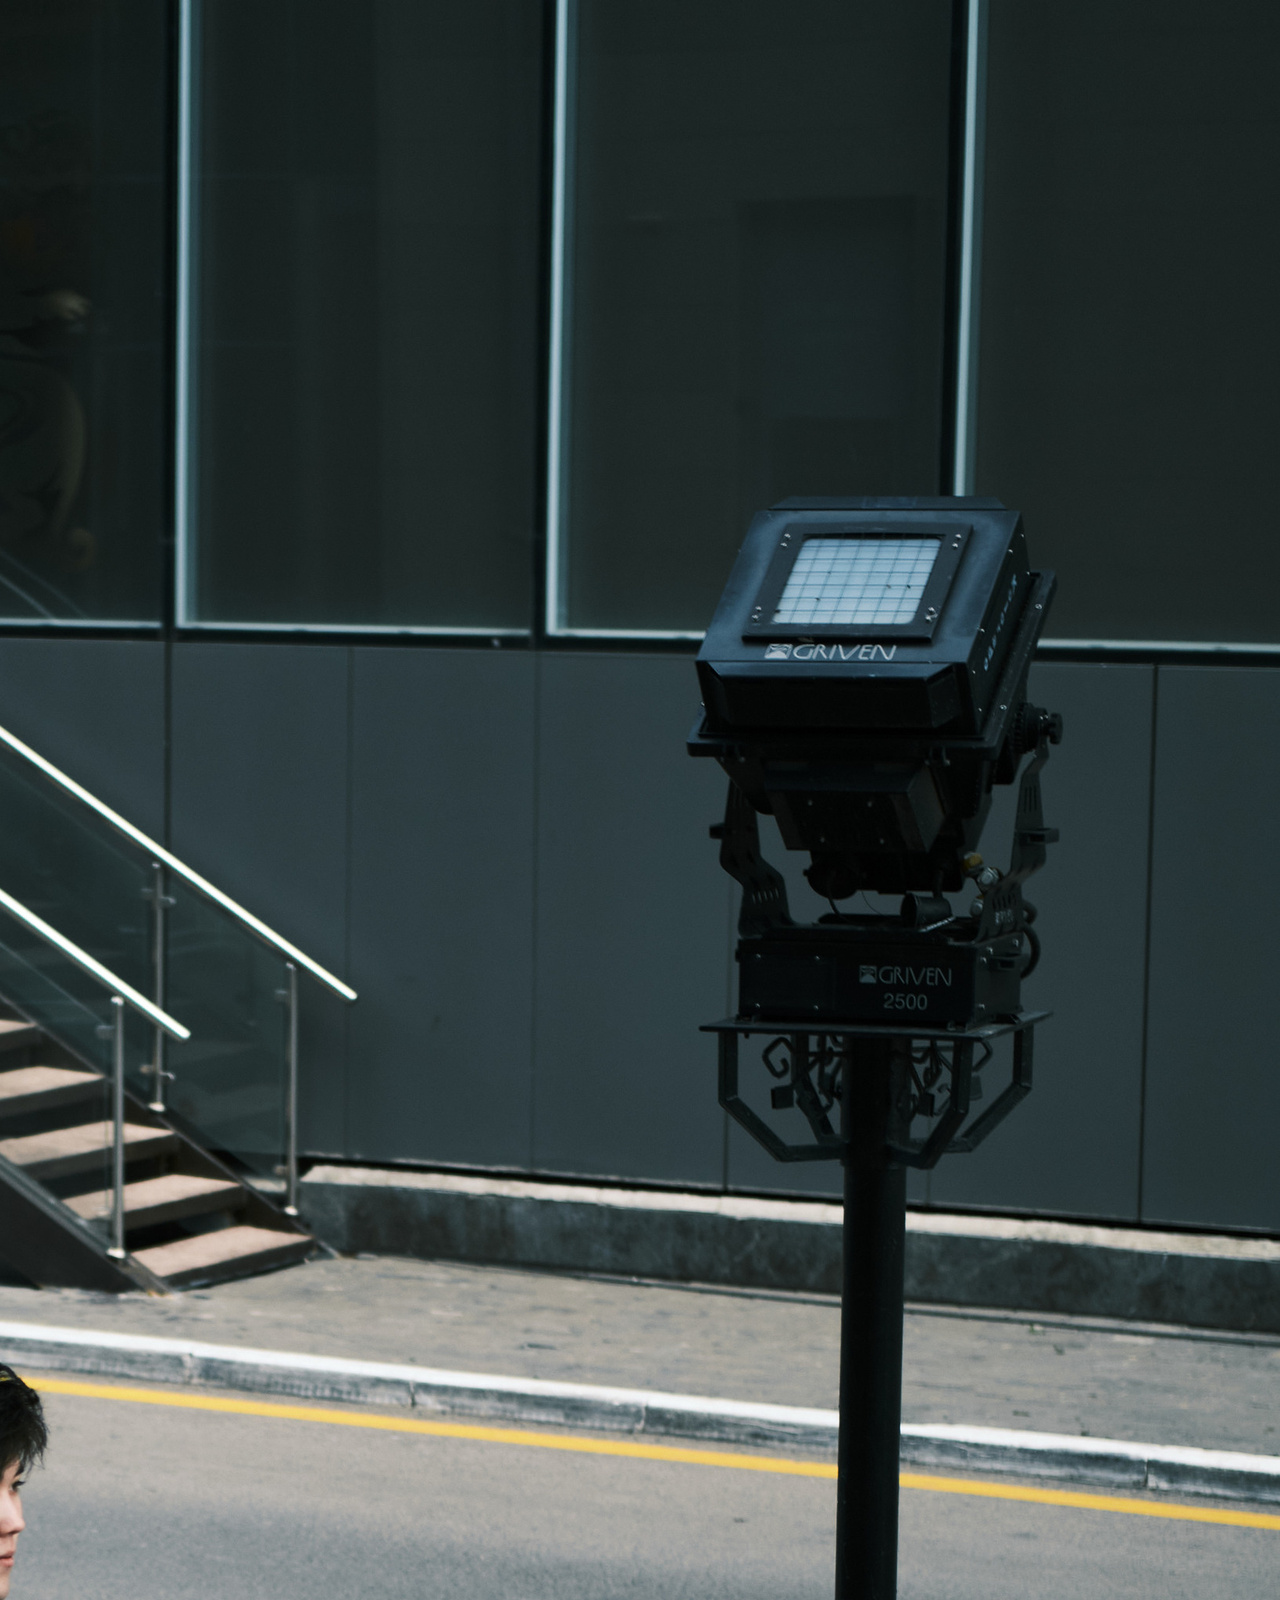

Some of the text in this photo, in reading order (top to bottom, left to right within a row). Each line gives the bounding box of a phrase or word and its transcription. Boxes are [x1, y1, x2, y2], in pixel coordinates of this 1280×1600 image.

[792, 643, 897, 660] GRIVEN
[878, 965, 952, 987] GRIVEN
[883, 993, 929, 1011] 2500
